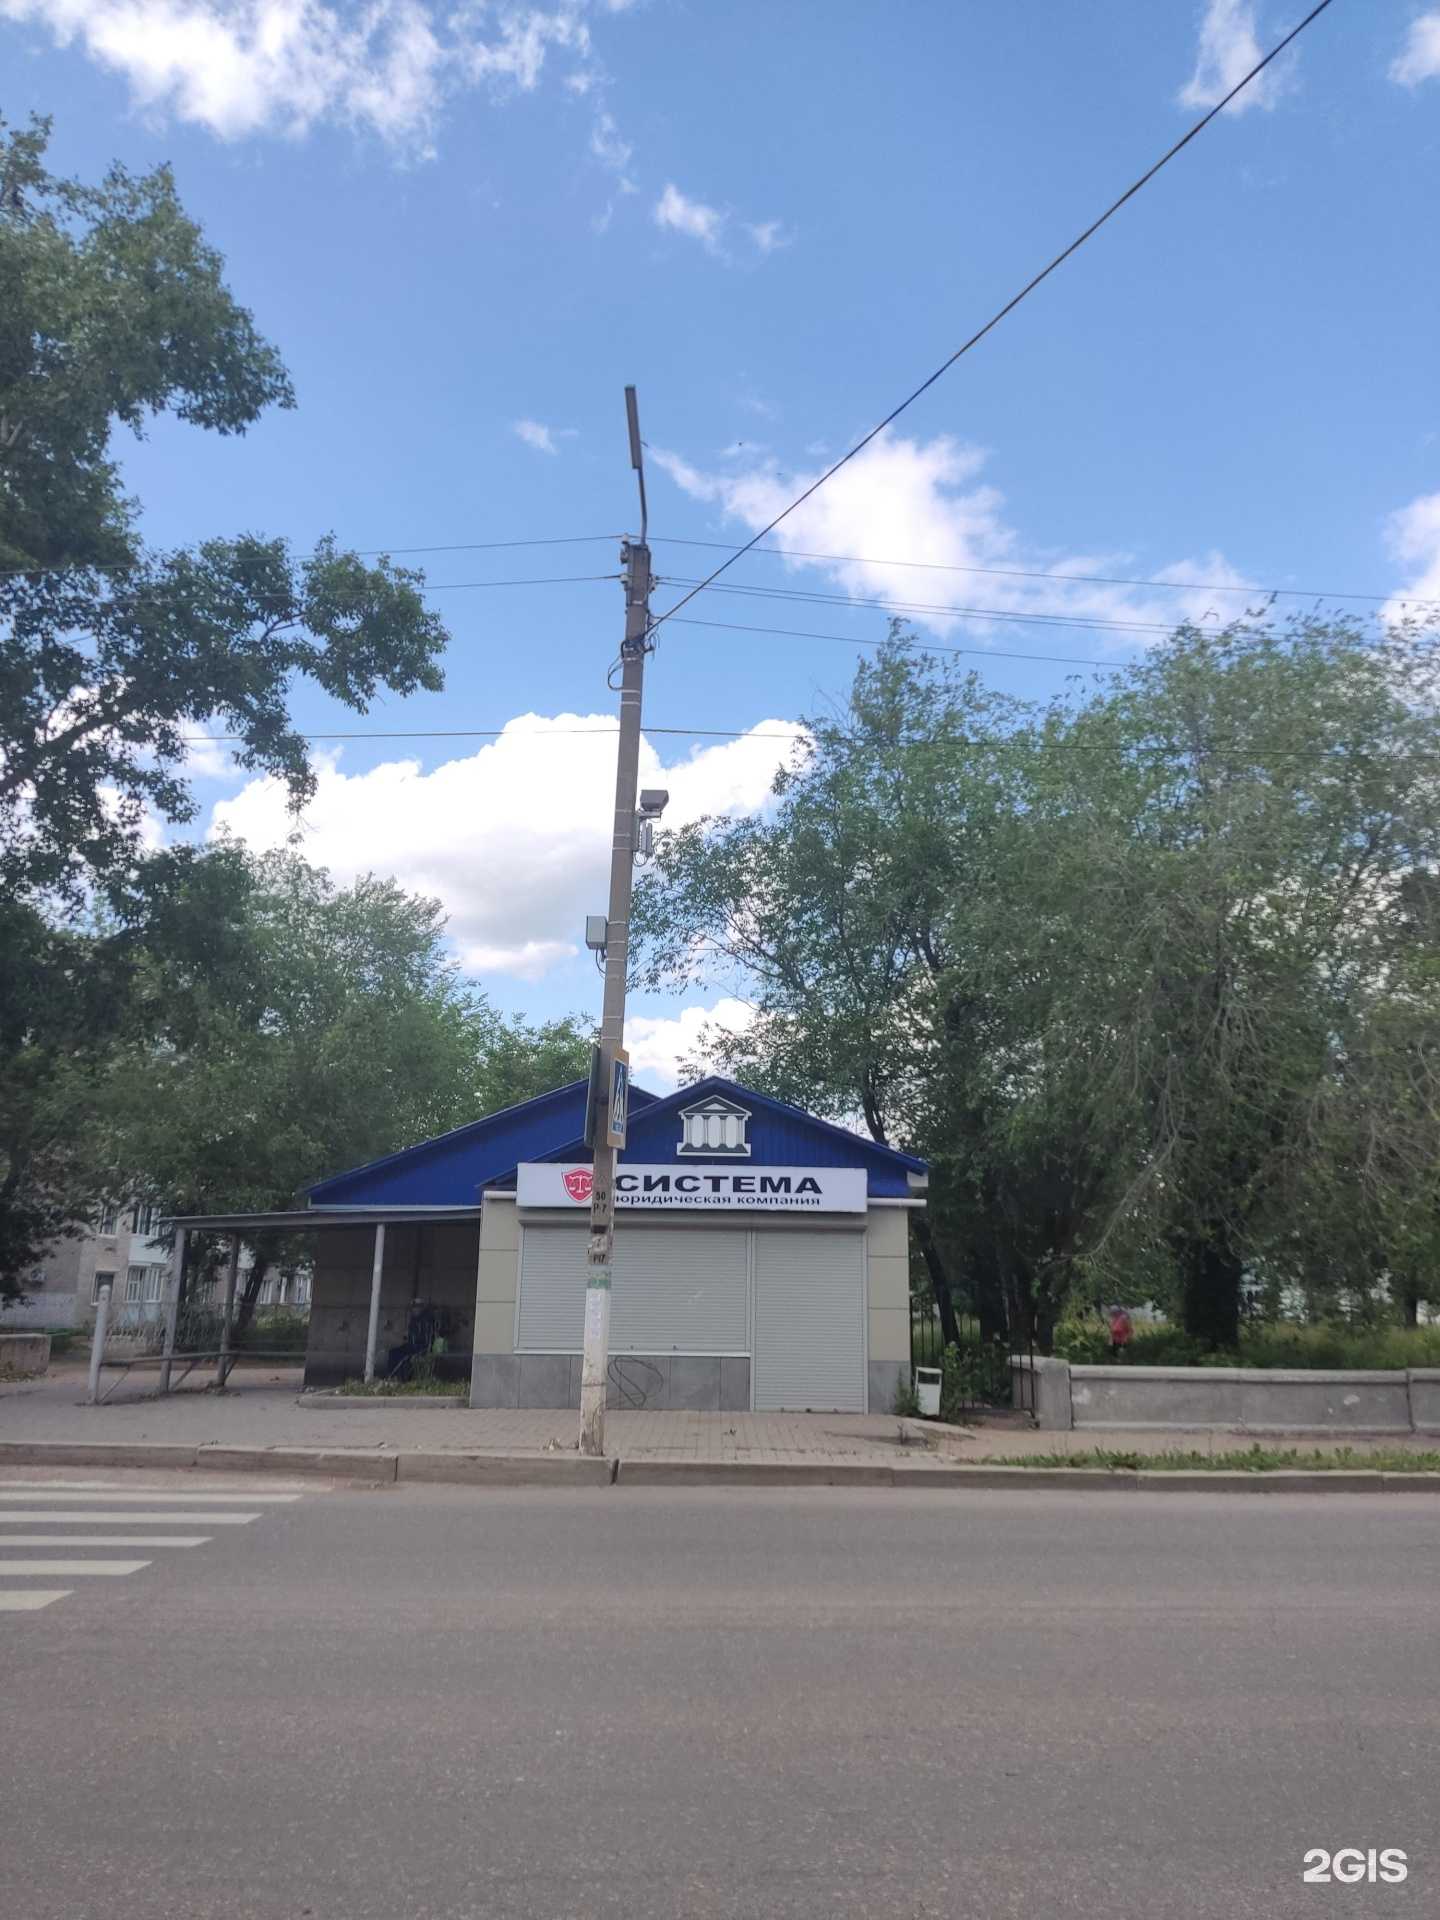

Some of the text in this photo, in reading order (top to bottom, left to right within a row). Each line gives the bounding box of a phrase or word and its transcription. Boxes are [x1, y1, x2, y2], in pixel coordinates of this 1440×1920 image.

[616, 1174, 822, 1194] СИСТЕМА
[616, 1195, 820, 1206] юридическая компания
